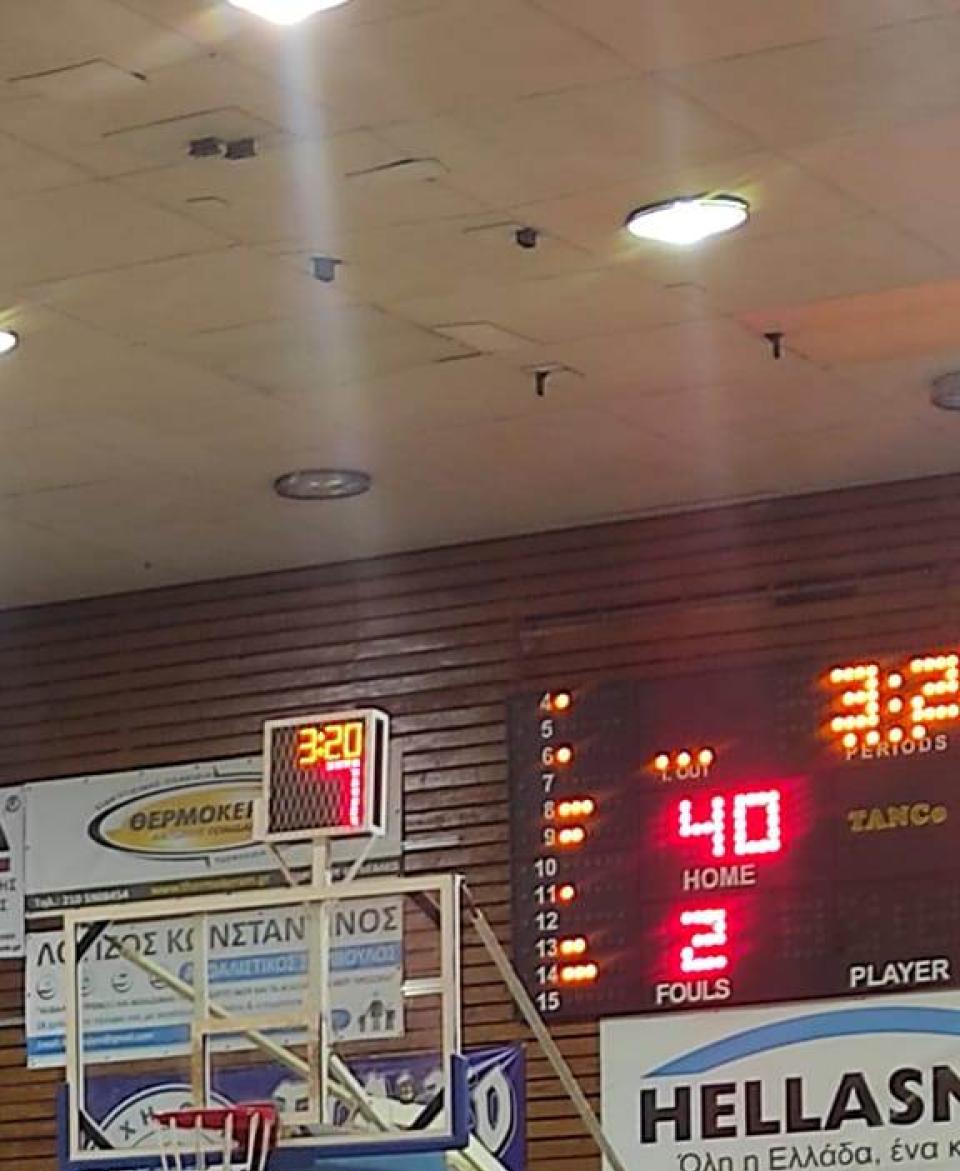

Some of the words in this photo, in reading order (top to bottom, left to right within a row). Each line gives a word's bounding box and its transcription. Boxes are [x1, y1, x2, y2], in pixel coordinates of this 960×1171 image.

[540, 692, 553, 711] 4
[541, 719, 553, 738] 5
[298, 722, 362, 766] 3:20
[846, 734, 948, 761] PERIODS
[542, 747, 554, 766] 6
[326, 759, 360, 826] 7
[542, 774, 555, 793] 7
[544, 800, 555, 819] 8
[678, 788, 782, 857] 40
[544, 827, 555, 846] 9
[535, 857, 557, 878] 10
[683, 864, 756, 891] HOME
[535, 884, 557, 905] 11
[535, 911, 559, 932] 12
[535, 937, 559, 958] 13
[679, 907, 729, 974] 2
[536, 964, 559, 985] 14
[849, 958, 951, 988] PLAYER
[537, 991, 560, 1012] 15
[655, 977, 732, 1005] FOULS
[769, 1142, 882, 1171] Ελλάδα,
[890, 1137, 939, 1163] ένα
